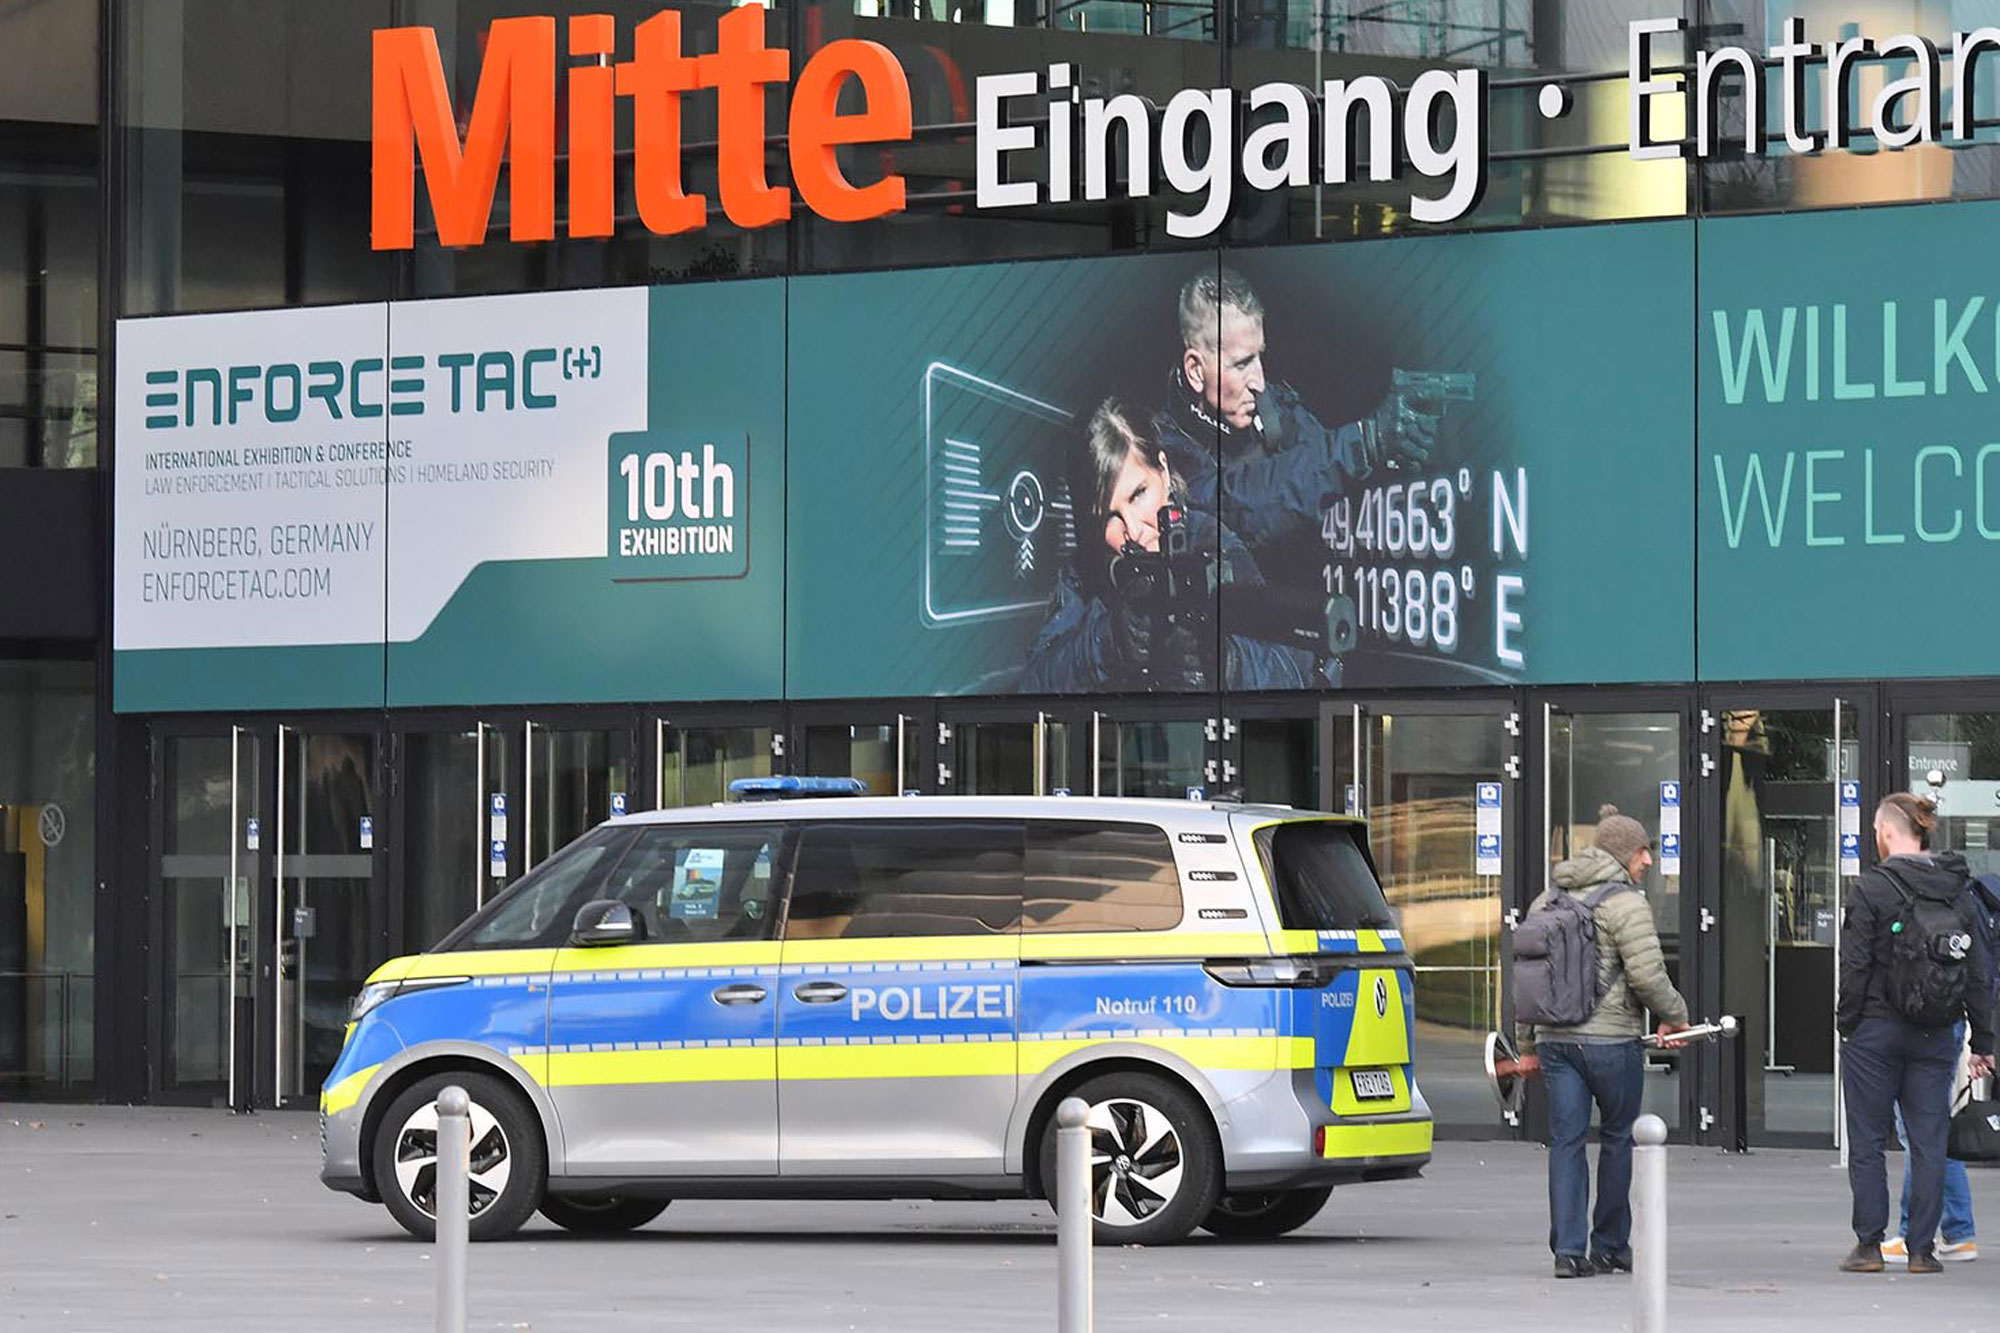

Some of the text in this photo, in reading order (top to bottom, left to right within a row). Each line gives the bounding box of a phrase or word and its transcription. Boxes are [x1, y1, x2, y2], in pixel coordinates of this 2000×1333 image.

[371, 3, 912, 251] Mitte
[975, 62, 1484, 239] Eingang
[1712, 296, 2000, 404] WILLK
[145, 355, 425, 429] ENFORCE
[145, 440, 413, 470] INTERNATIONAL EXHIBITION & CONFERENCE
[145, 459, 555, 496] LAW ENFORCEMENT TACTICAL SOLUTIONS HOMELAND SECURITY
[620, 443, 734, 521] 10th
[1493, 467, 1526, 556] N
[143, 521, 374, 559] NÜRNBERG, GERMANY
[620, 525, 733, 556] EXHIBITION
[143, 567, 331, 602] ENFORCETAC.COM
[1497, 575, 1524, 665] E
[1908, 756, 1958, 772] Entrance
[850, 983, 1015, 1022] POLIZEI
[1095, 995, 1197, 1017] Notruf 110
